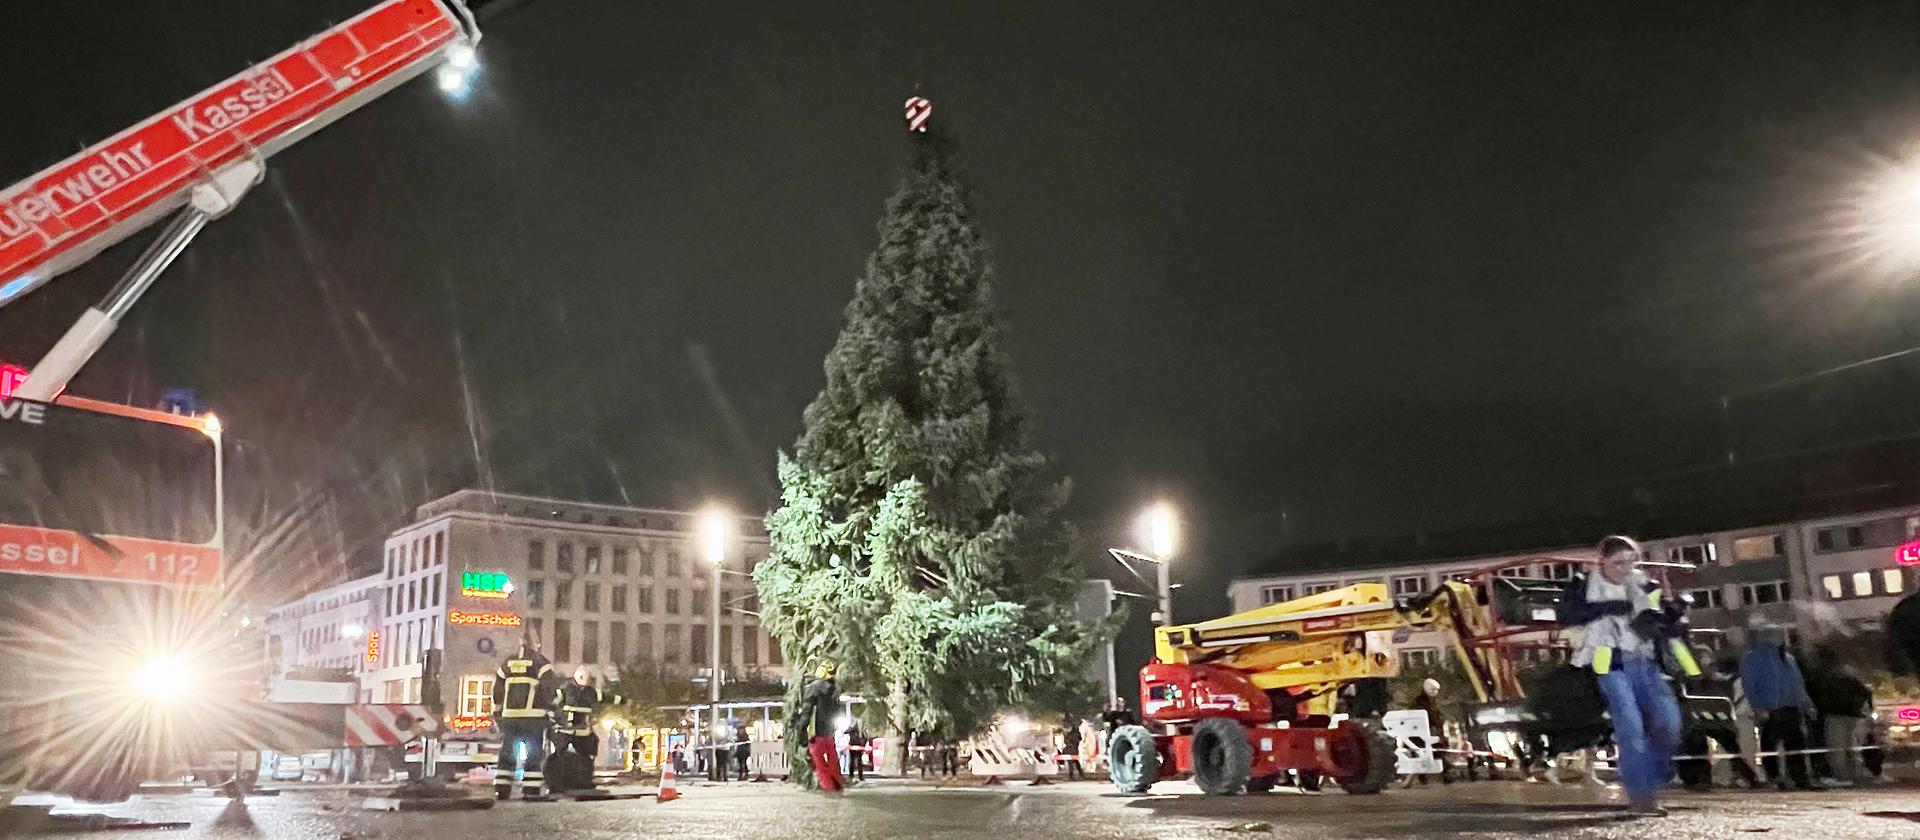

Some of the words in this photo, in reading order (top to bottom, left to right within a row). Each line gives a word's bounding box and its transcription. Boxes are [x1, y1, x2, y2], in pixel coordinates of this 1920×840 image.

[172, 66, 294, 142] Kassel
[144, 552, 199, 576] 112
[450, 612, 521, 626] SportScheck
[367, 631, 379, 662] Sport
